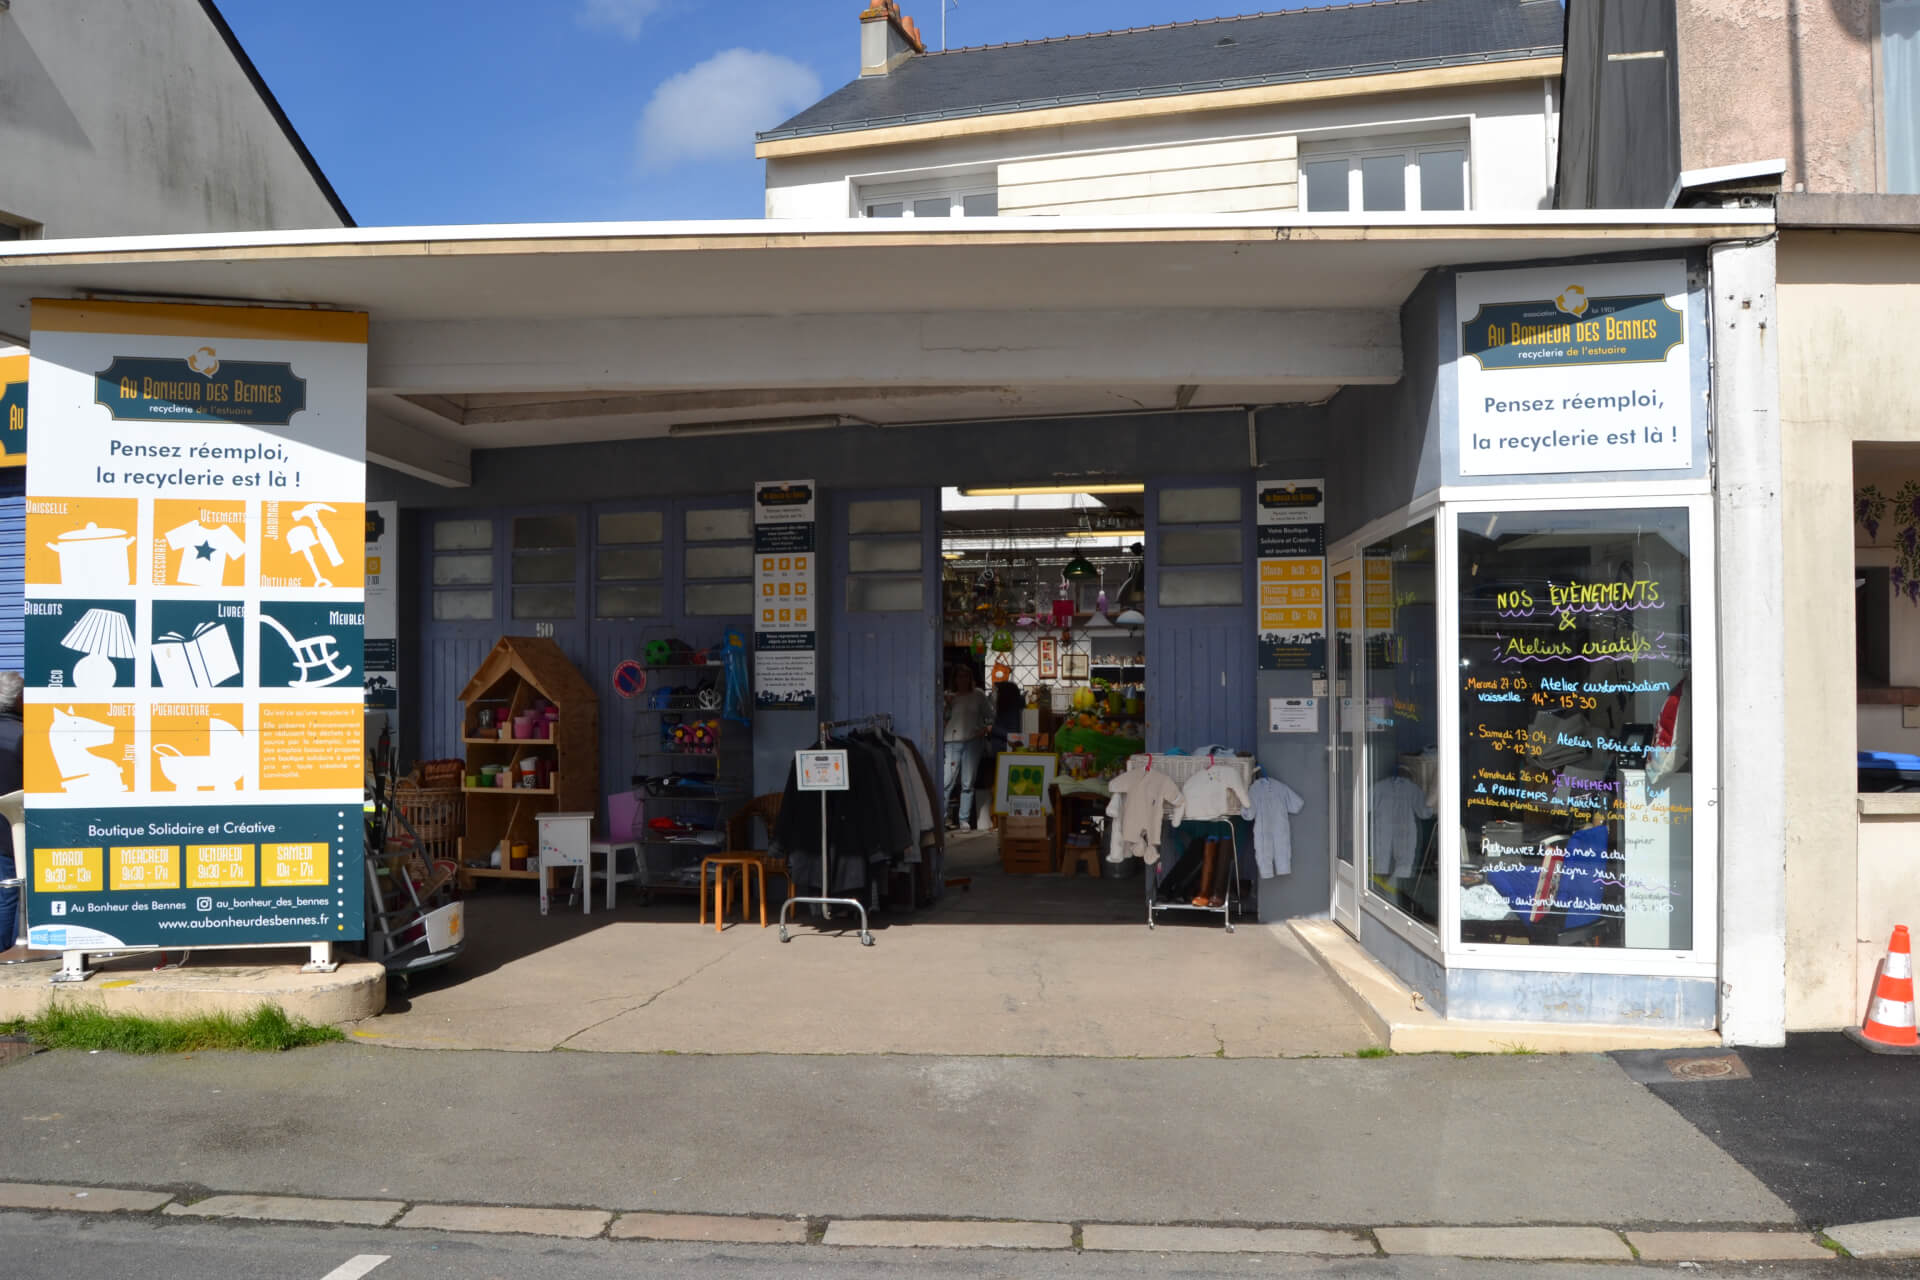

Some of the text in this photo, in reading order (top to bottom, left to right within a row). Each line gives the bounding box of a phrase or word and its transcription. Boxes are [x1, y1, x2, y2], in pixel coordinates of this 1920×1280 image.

[1518, 345, 1627, 360] recyclerie de l'estuaire
[149, 403, 253, 416] recyclerie de l'estuaire
[1485, 389, 1665, 413] Pensez réemploi,
[1472, 433, 1491, 450] la
[1499, 428, 1599, 453] recyclerie
[1607, 428, 1637, 445] est
[1643, 426, 1663, 444] là
[109, 440, 289, 464] Pensez réemploi,
[96, 467, 115, 486] la
[123, 466, 225, 489] recyclerie
[232, 472, 262, 487] est
[268, 469, 288, 488] là
[1497, 590, 1533, 608] NOS
[1558, 611, 1577, 631] &
[536, 622, 554, 638] 50
[1506, 631, 1652, 664] Ateliers créatifs
[1540, 677, 1579, 691] Atelier
[1583, 679, 1671, 693] customisation
[1478, 724, 1514, 739] Samedi
[1556, 732, 1593, 749] Atelier
[1478, 768, 1517, 781] Vendredi
[1491, 783, 1549, 802] PRINTEMPS
[88, 821, 276, 839] Boutique Solidaire et Créative
[121, 848, 169, 864] MERCREDI
[198, 847, 243, 863] VENDREDI
[276, 846, 313, 861] SAMEDI
[1481, 838, 1534, 856] Retrouvez
[1537, 844, 1571, 857] toutes
[1573, 848, 1597, 857] nos
[52, 851, 84, 866] MARDI
[1477, 860, 1526, 873] ateliers
[1531, 865, 1549, 873] en
[1554, 863, 1588, 880] ligne
[1593, 867, 1616, 880] sur
[71, 901, 187, 913] Au Bonheur des Bennes
[216, 896, 329, 910] au_bonheur_des_bennes
[158, 914, 329, 930] www.aubonheurdesbennes.fr
